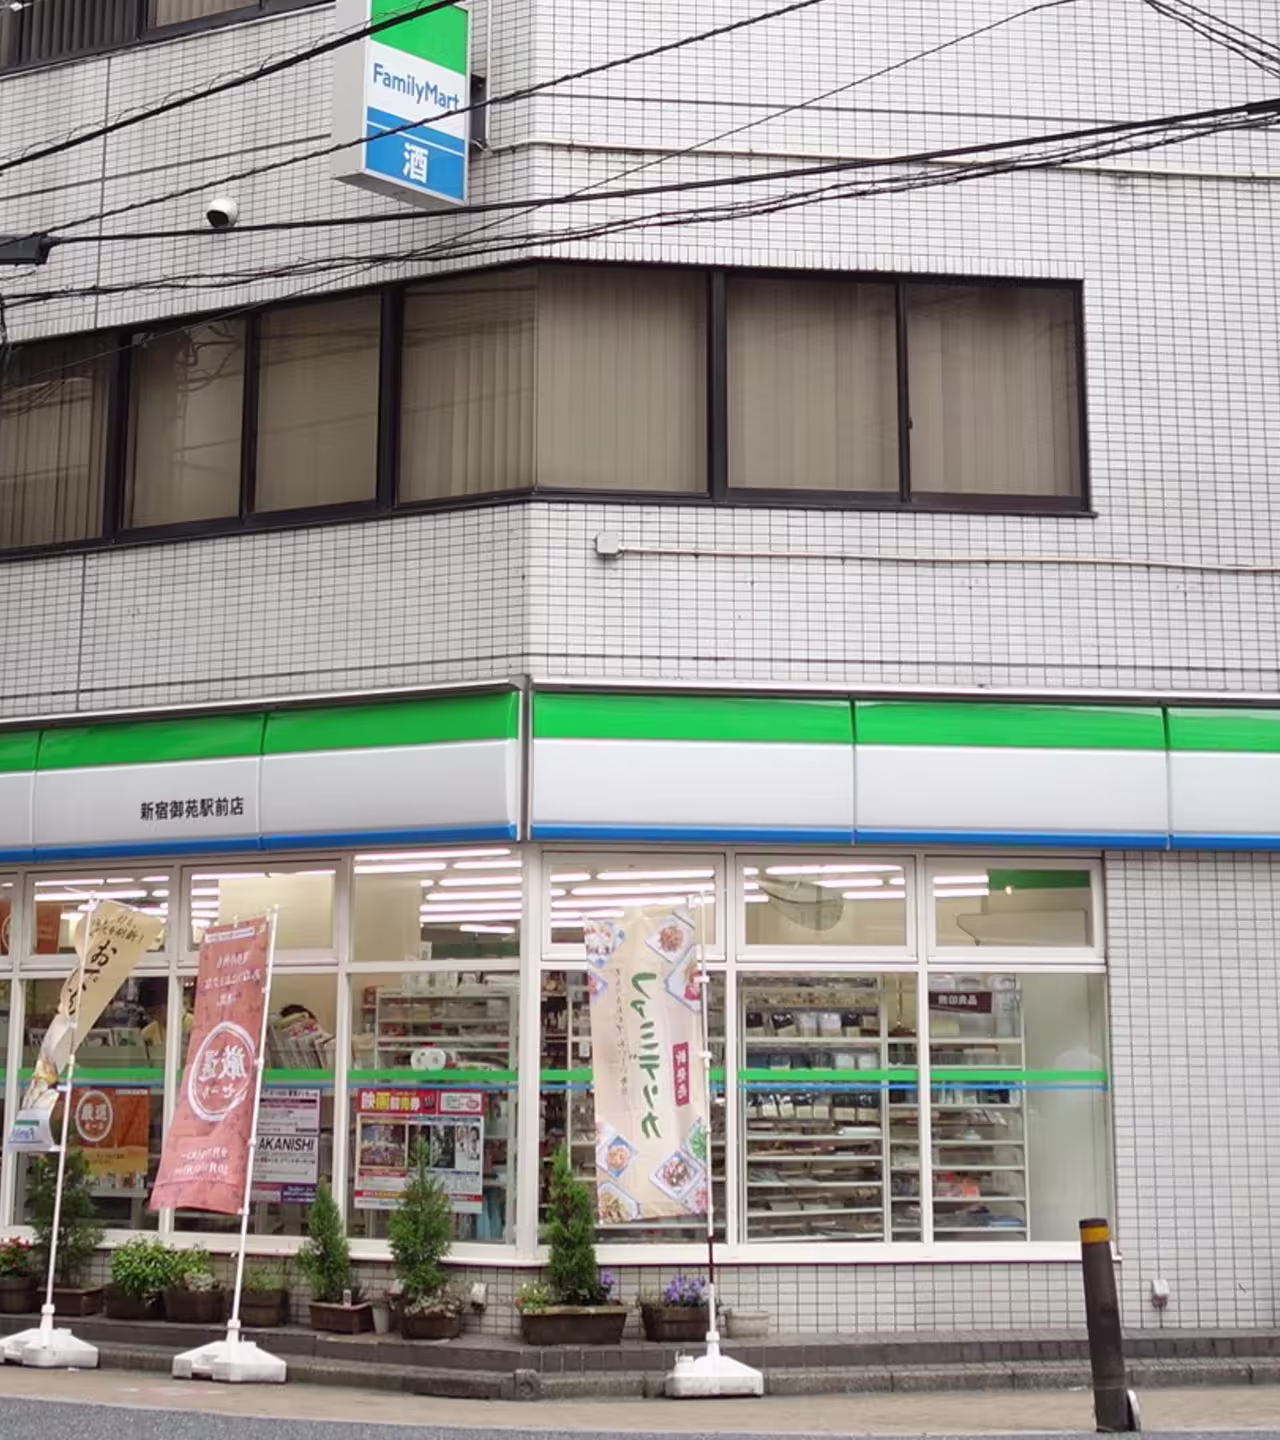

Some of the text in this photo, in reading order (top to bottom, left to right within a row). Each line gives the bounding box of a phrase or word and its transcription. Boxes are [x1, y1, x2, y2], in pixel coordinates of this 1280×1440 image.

[373, 62, 460, 110] FamilyMart
[403, 142, 428, 183] 酒
[140, 797, 244, 820] 新宿御苑駅前店
[258, 1137, 314, 1152] AKANISHI
